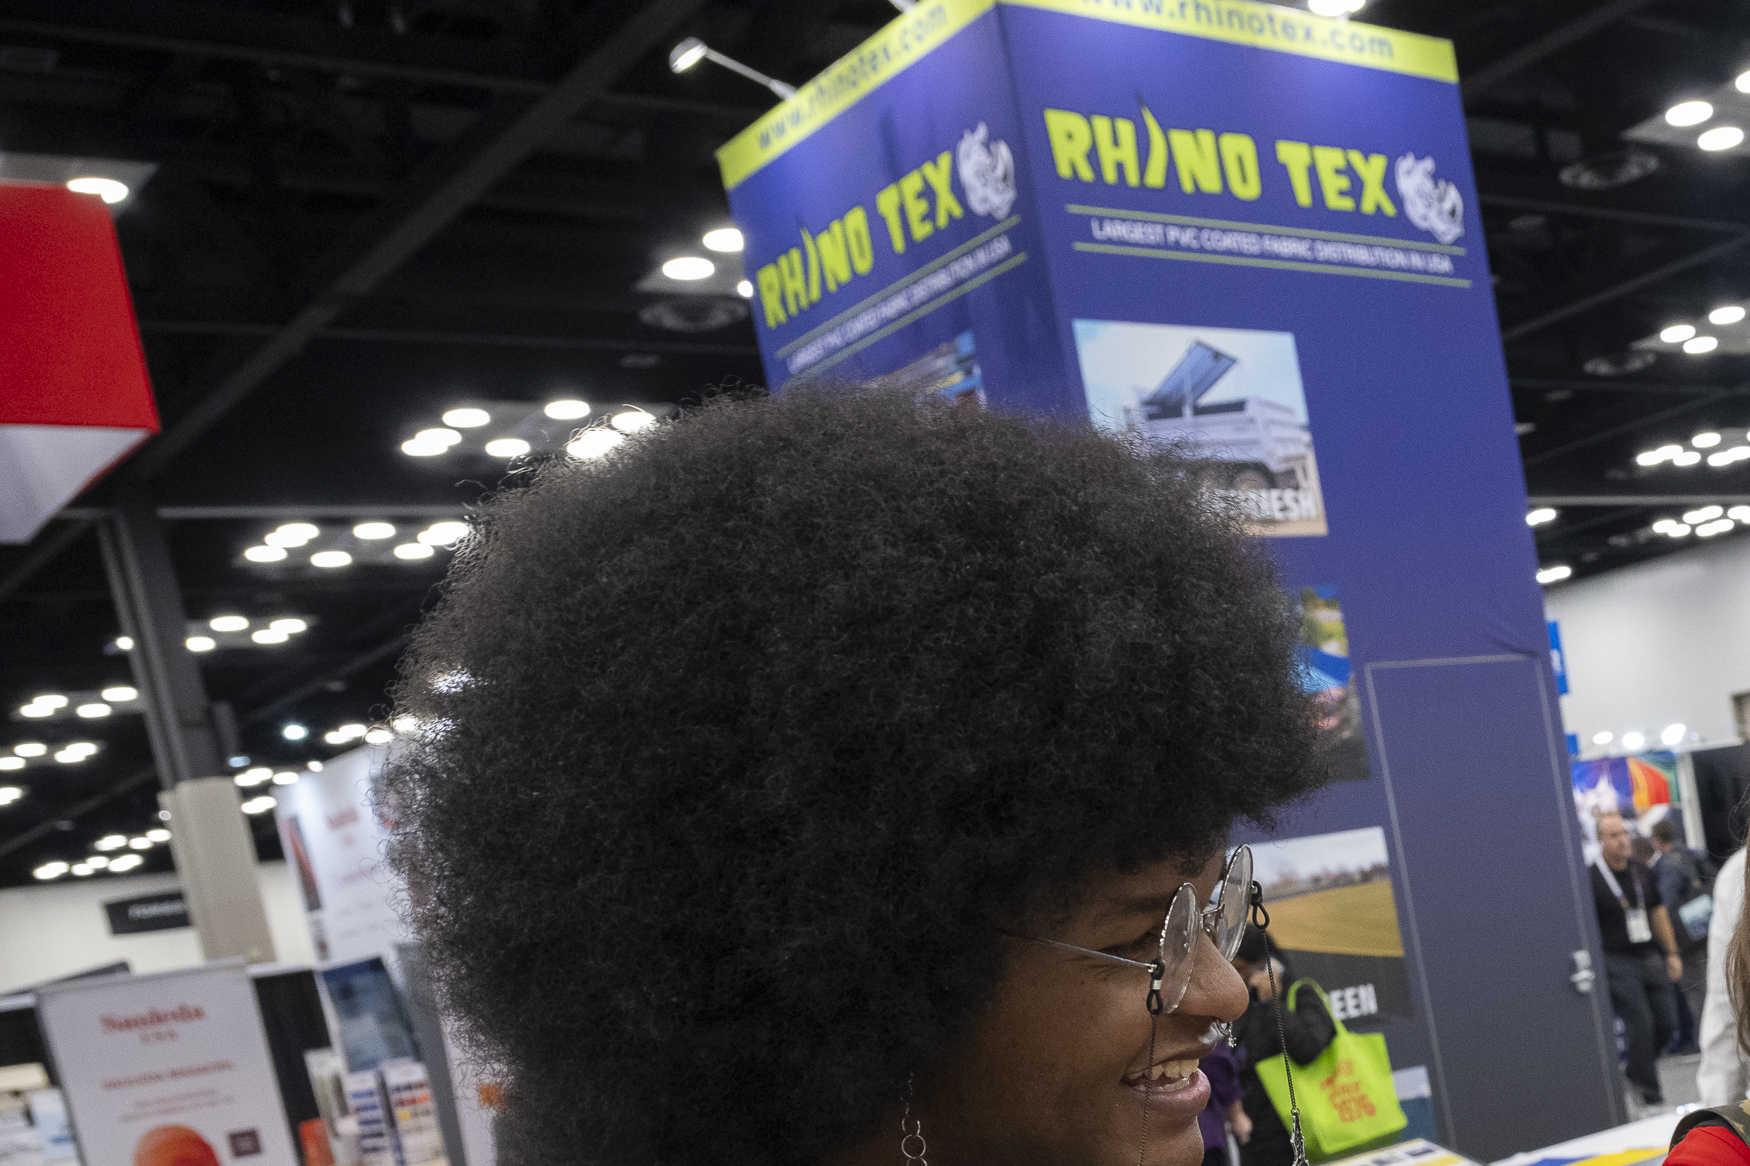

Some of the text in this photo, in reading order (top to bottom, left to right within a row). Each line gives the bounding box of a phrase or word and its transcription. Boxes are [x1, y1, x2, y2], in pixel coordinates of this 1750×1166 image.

[1081, 0, 1395, 60] w.rhinotex.com
[1043, 97, 1397, 217] RHINO TEX
[756, 150, 964, 329] RHINO TEX
[1165, 224, 1201, 249] PVC
[1326, 982, 1379, 1021] EEN
